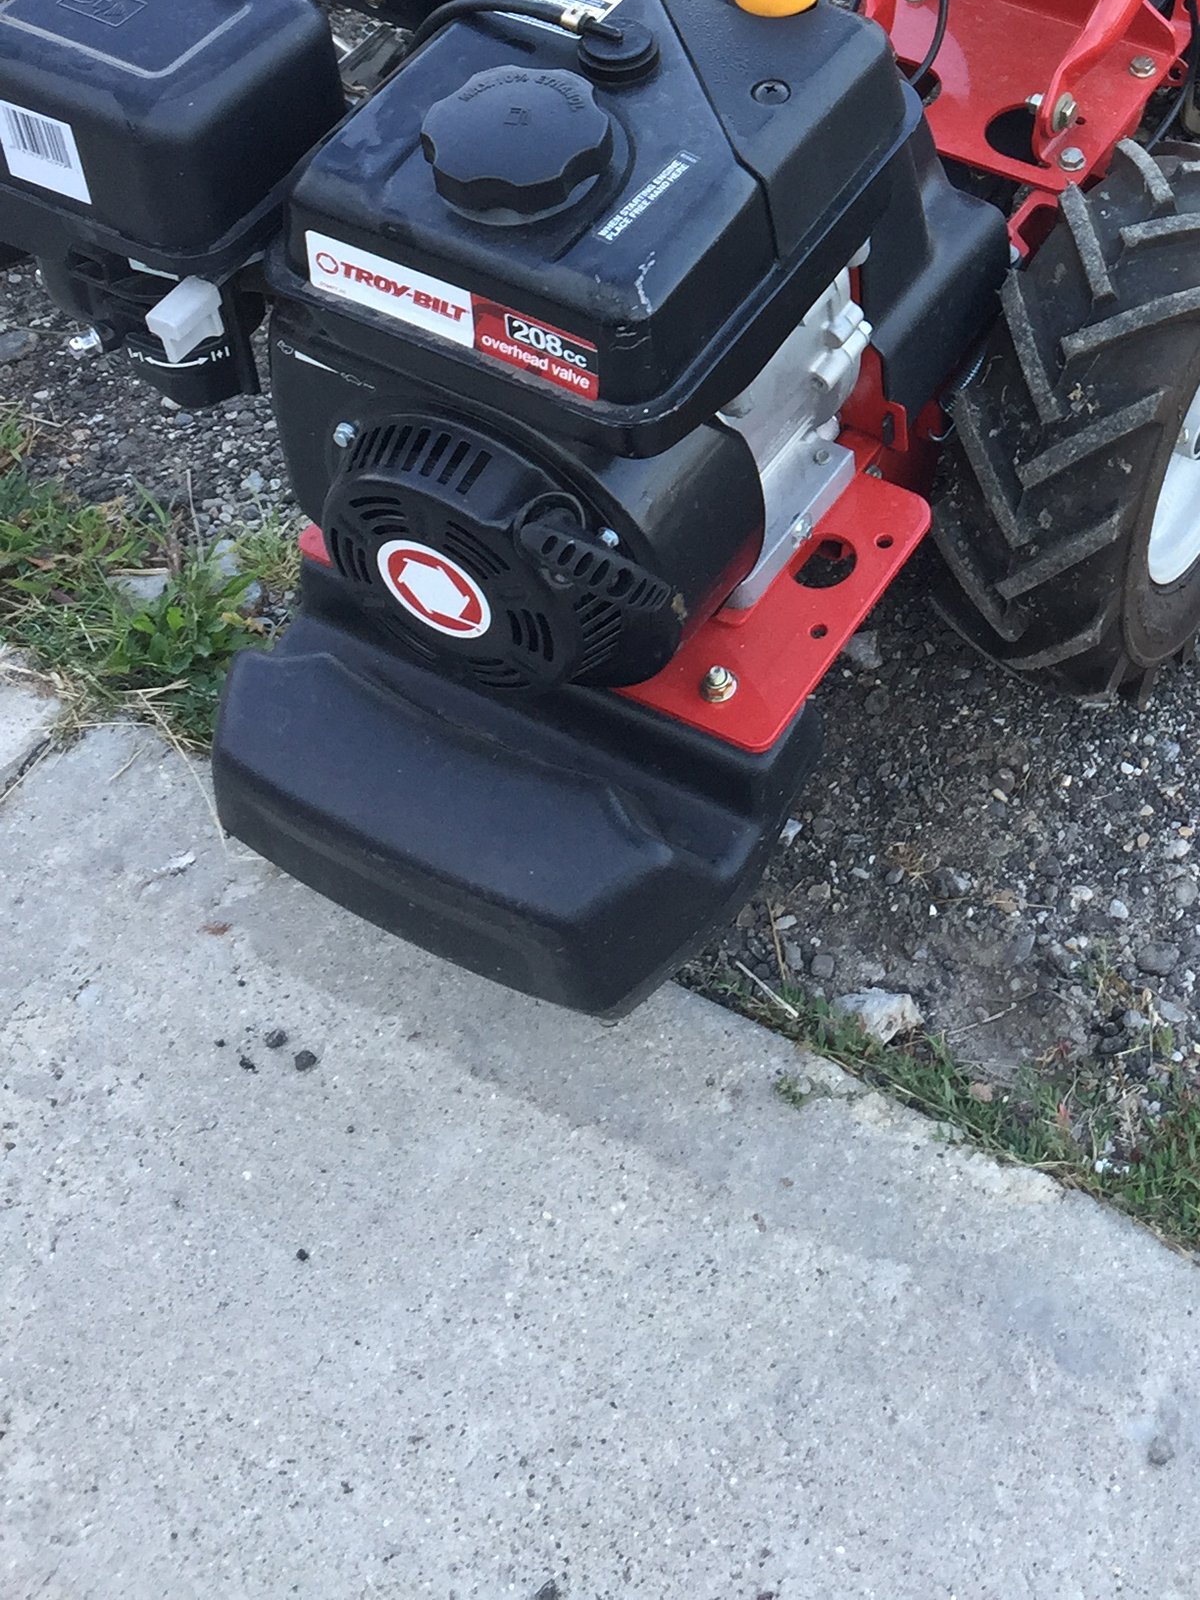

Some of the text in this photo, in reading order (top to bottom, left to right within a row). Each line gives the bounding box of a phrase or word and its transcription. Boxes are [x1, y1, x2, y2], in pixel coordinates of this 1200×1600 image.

[597, 159, 682, 236] WHEN STARTING ENGINE
[605, 163, 690, 240] PLACE FREE HAND HERE
[341, 261, 467, 322] TROY-BILT
[481, 333, 591, 390] overhead valve
[511, 320, 588, 368] 208cc
